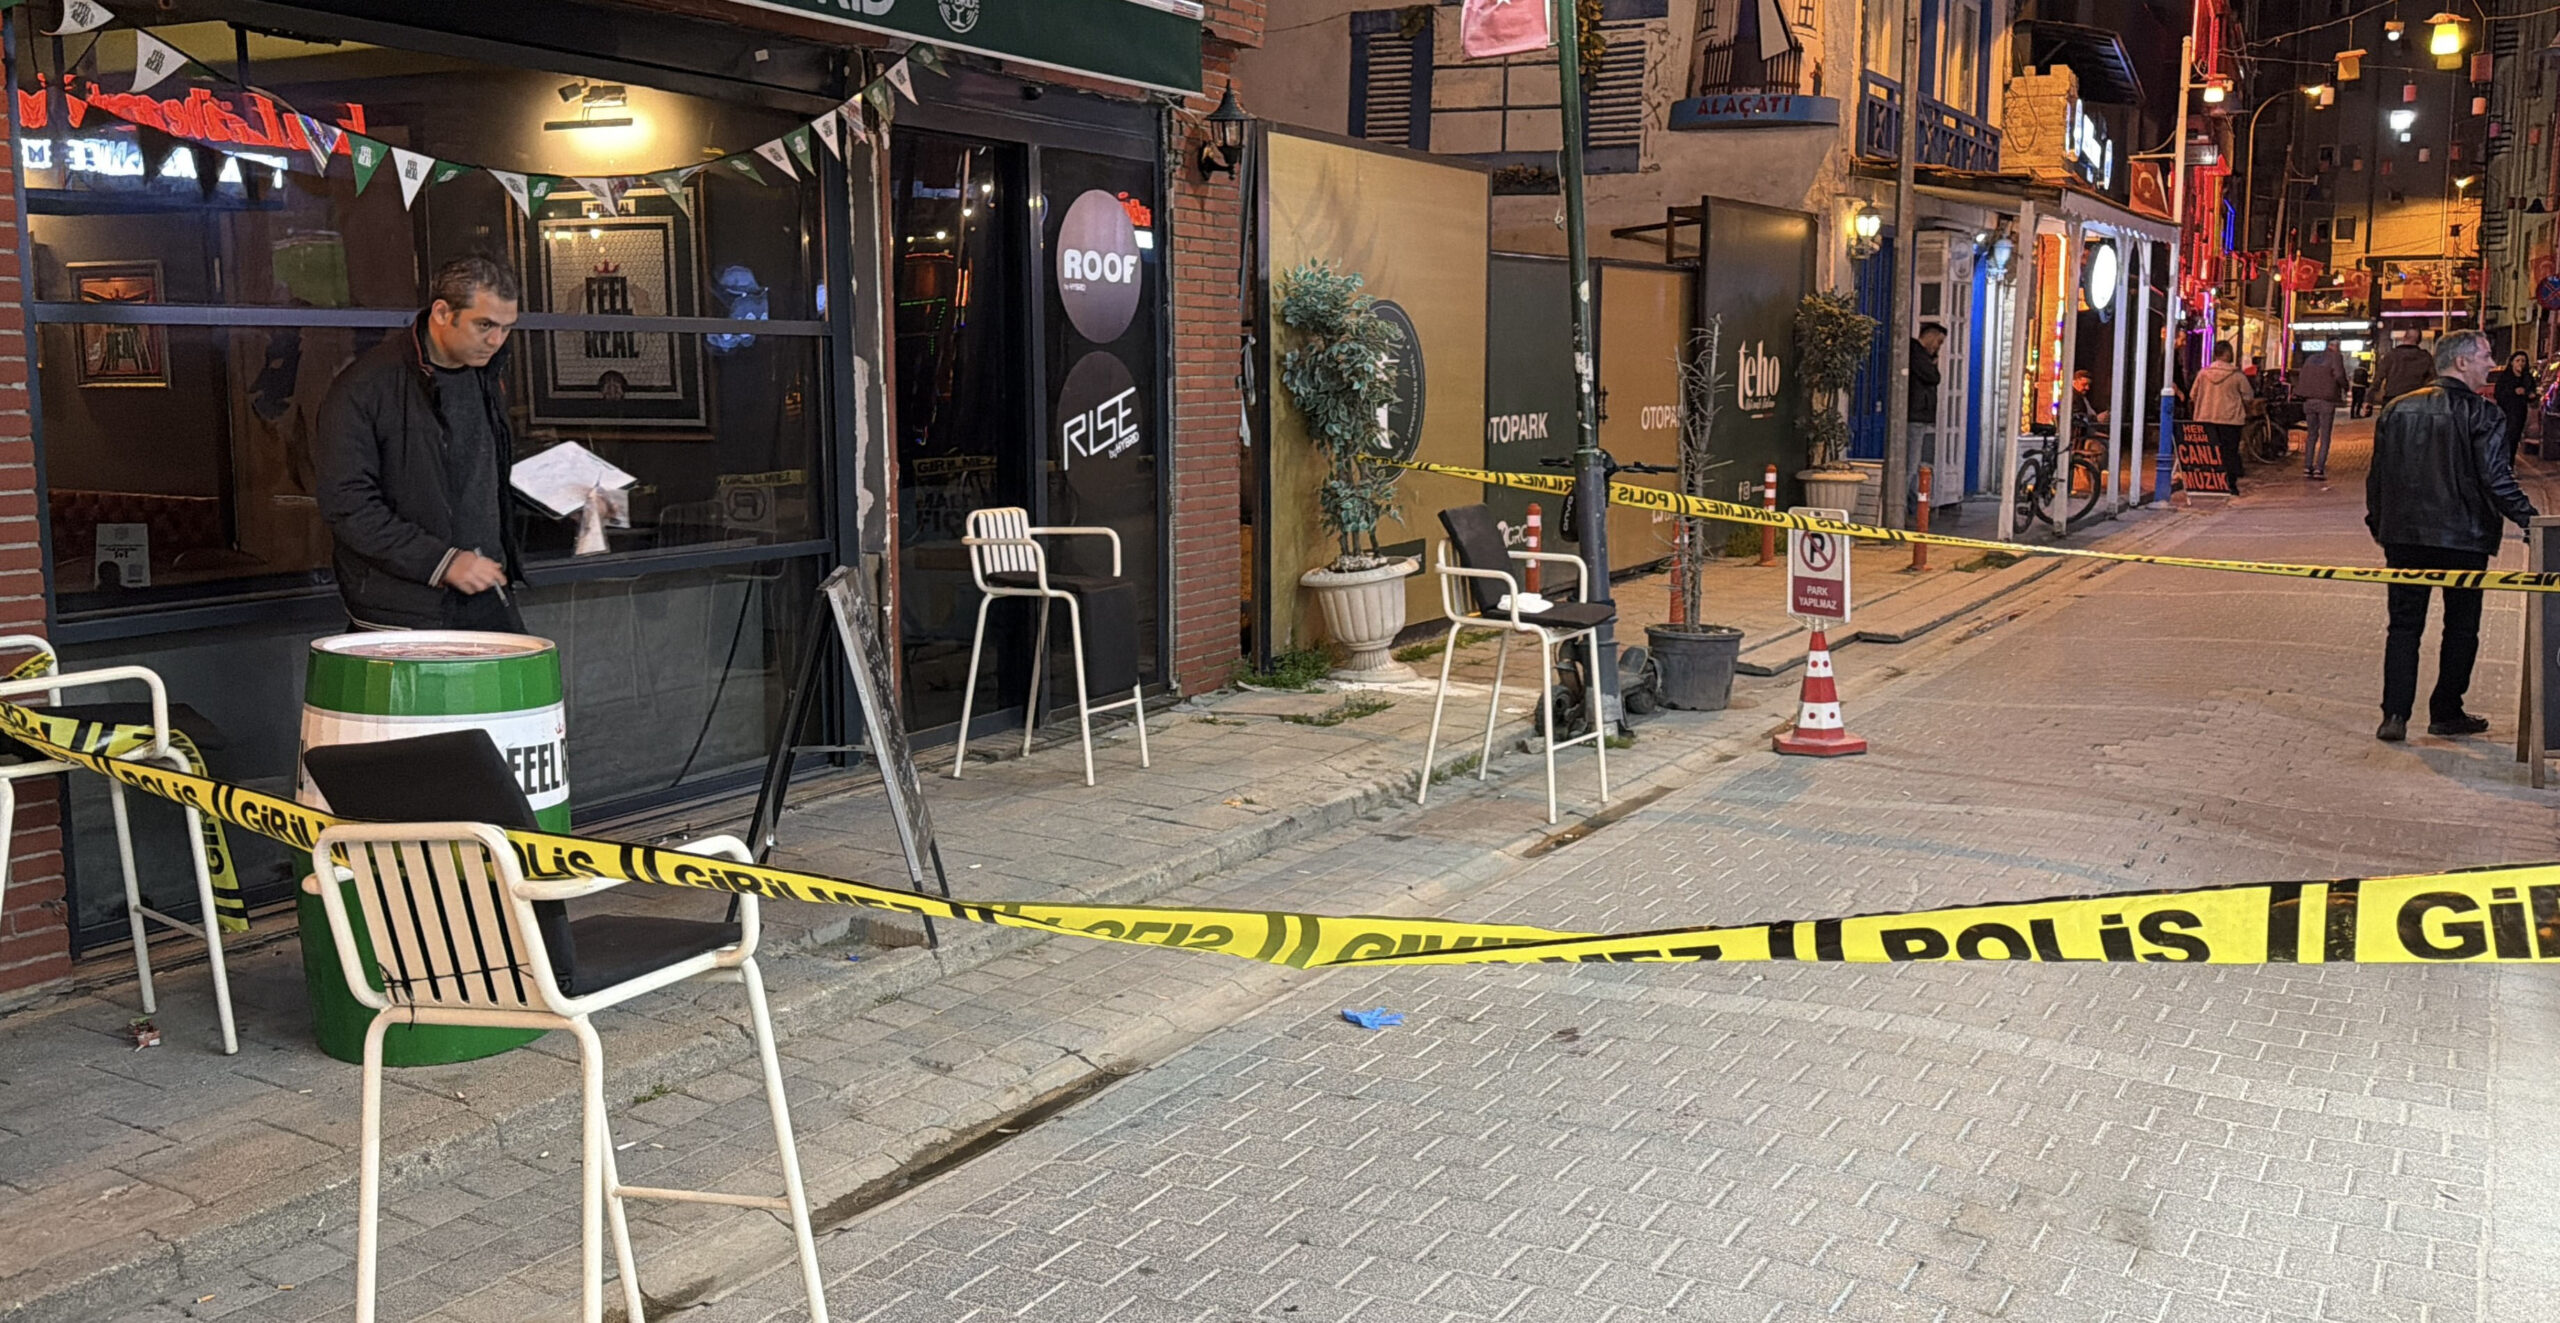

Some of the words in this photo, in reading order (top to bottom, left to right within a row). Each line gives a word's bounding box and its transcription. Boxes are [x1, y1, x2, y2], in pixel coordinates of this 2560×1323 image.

[1697, 96, 1792, 118] ALAÇATI
[1064, 249, 1138, 283] ROOF
[1063, 386, 1137, 471] RISE
[1488, 412, 1549, 444] TOPARK
[2183, 424, 2205, 433] HER
[2179, 444, 2223, 465] CANLI
[2182, 467, 2231, 490] MÜZİK
[1807, 585, 1828, 596] PARK
[1799, 597, 1838, 610] YAPILMAZ
[506, 741, 560, 796] FEEL
